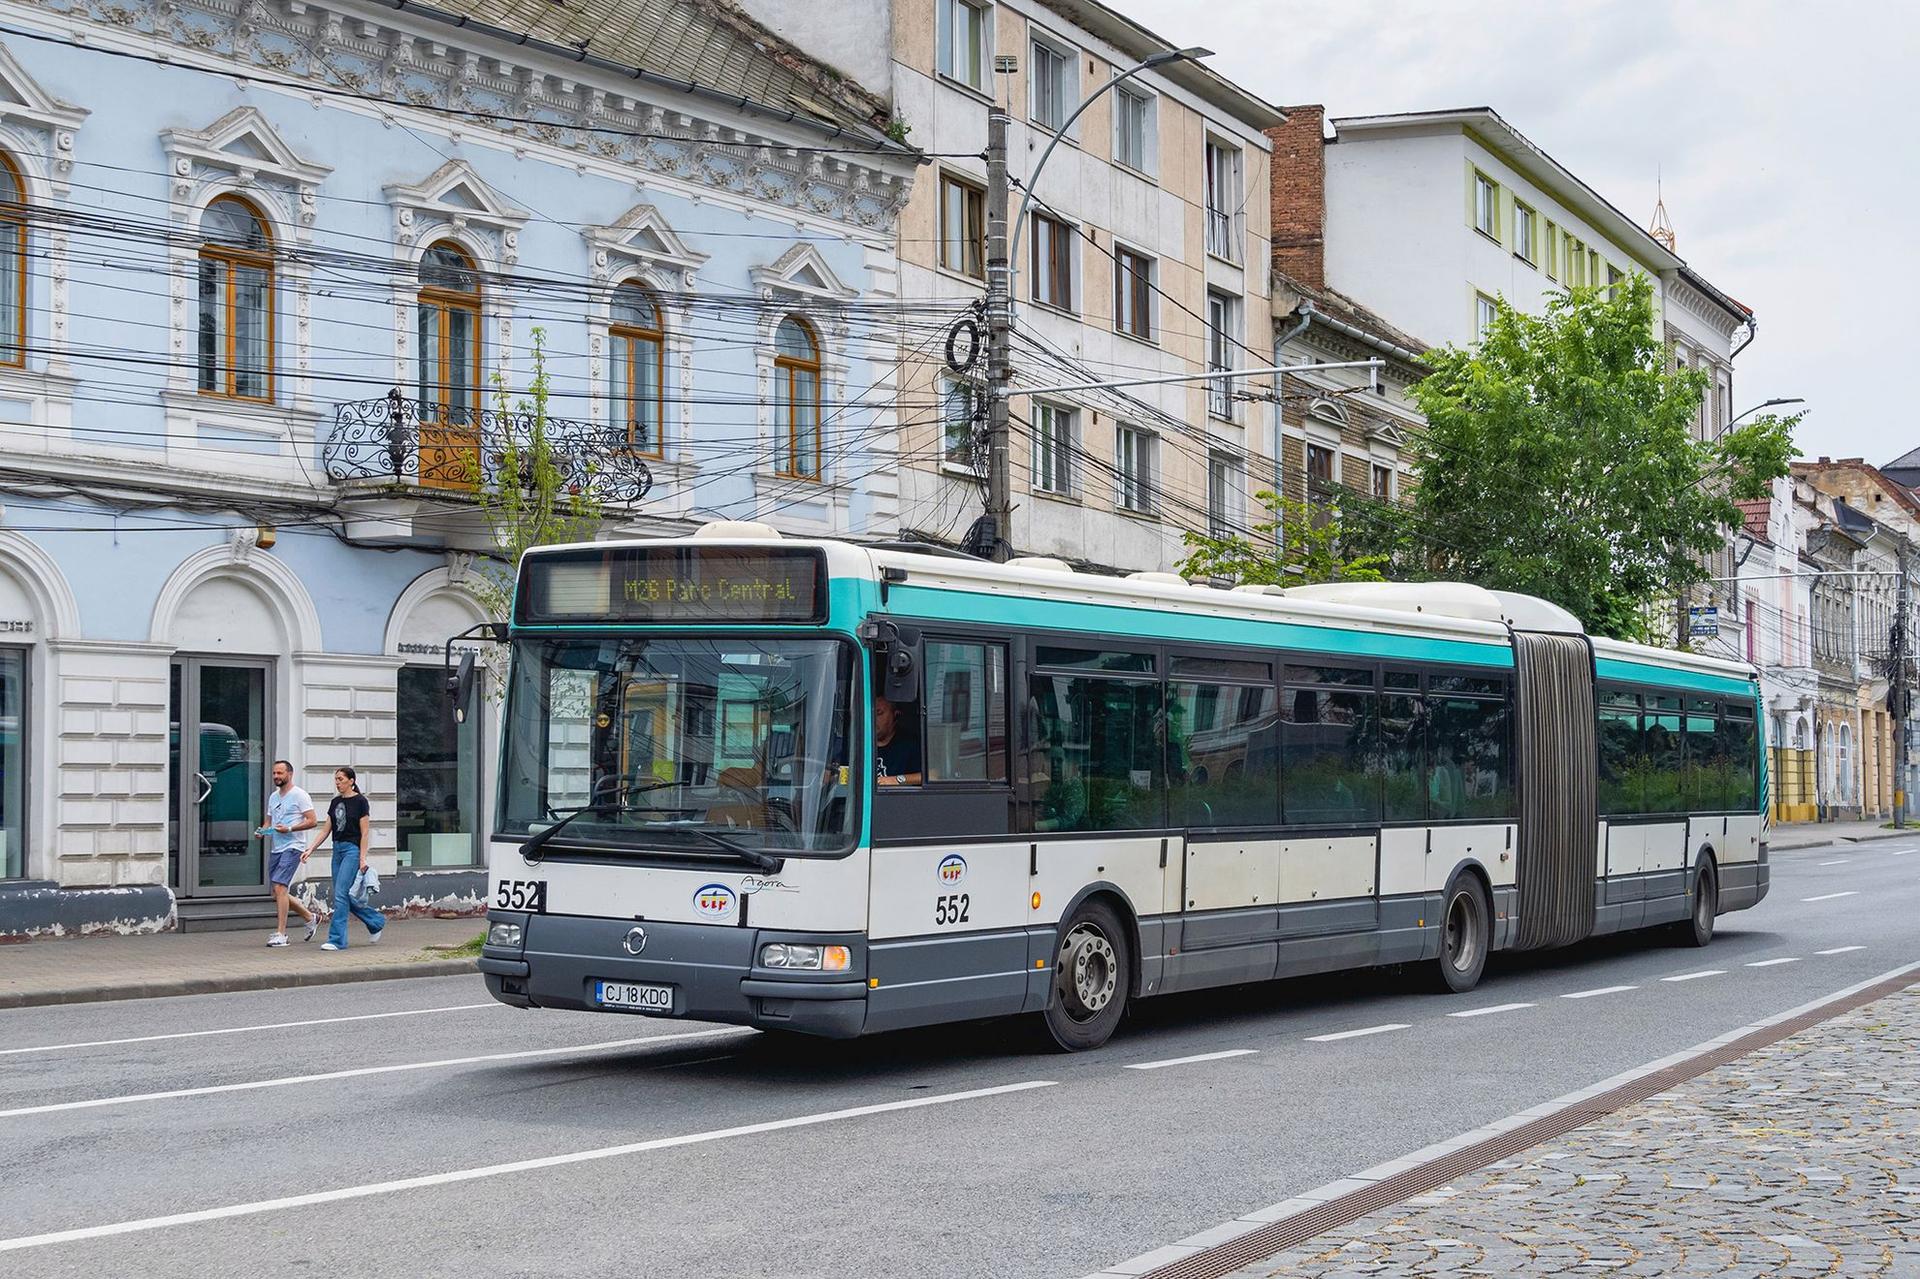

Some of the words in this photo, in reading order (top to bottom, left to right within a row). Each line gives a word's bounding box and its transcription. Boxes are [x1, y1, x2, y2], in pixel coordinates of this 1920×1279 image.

[667, 579, 711, 600] Parc
[719, 578, 795, 600] Central
[497, 879, 541, 910] 552
[740, 875, 797, 895] Agora
[936, 893, 970, 925] 552
[606, 985, 621, 1001] CJ
